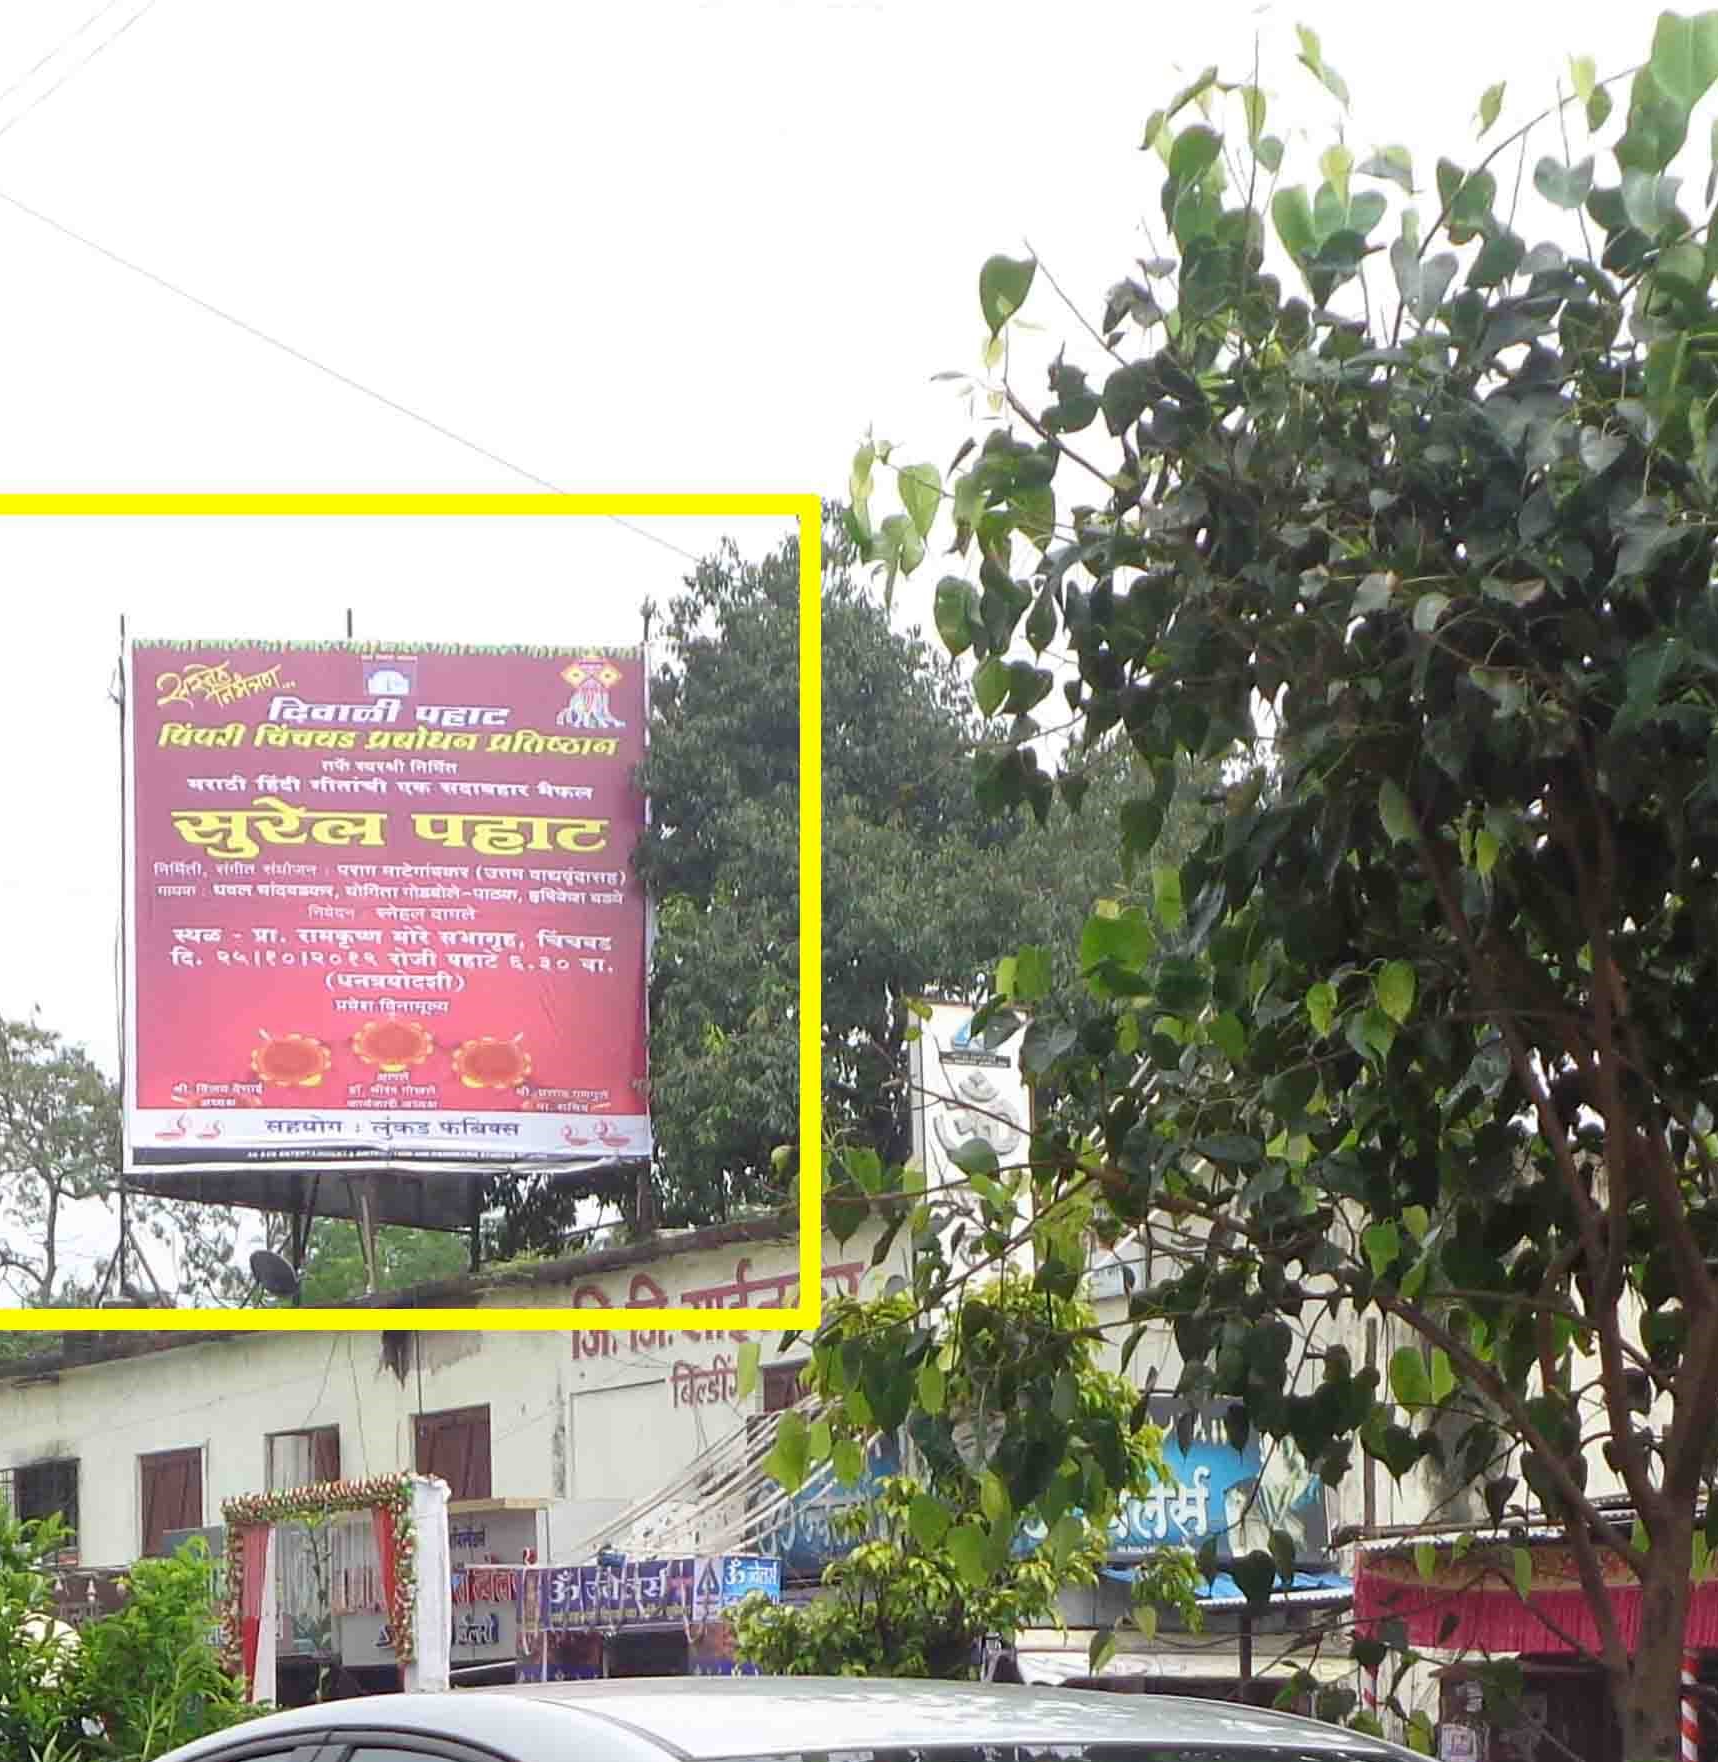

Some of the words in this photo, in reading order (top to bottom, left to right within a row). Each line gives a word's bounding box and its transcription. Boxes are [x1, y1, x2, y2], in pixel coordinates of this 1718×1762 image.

[267, 696, 403, 726] दिवाळी
[414, 704, 512, 728] पहाट
[156, 723, 247, 749] पिंपरी
[253, 723, 356, 749] चिंचवड
[364, 726, 480, 752] प्रबोधन
[487, 729, 619, 757] प्रतिष्ठान
[187, 777, 247, 794] मराठी
[256, 773, 300, 795] हिंदी
[311, 776, 389, 796] गीतांची
[396, 781, 431, 797] एक
[170, 796, 388, 858] सुरेल
[410, 813, 611, 858] पहाट
[172, 928, 222, 944] स्थळ
[251, 927, 287, 945] प्रा.
[297, 928, 383, 951] रामकृष्ण
[392, 926, 431, 945] मोरे
[169, 945, 203, 968] दि.
[387, 947, 438, 968] रोजी
[265, 1114, 344, 1135] सहयोग
